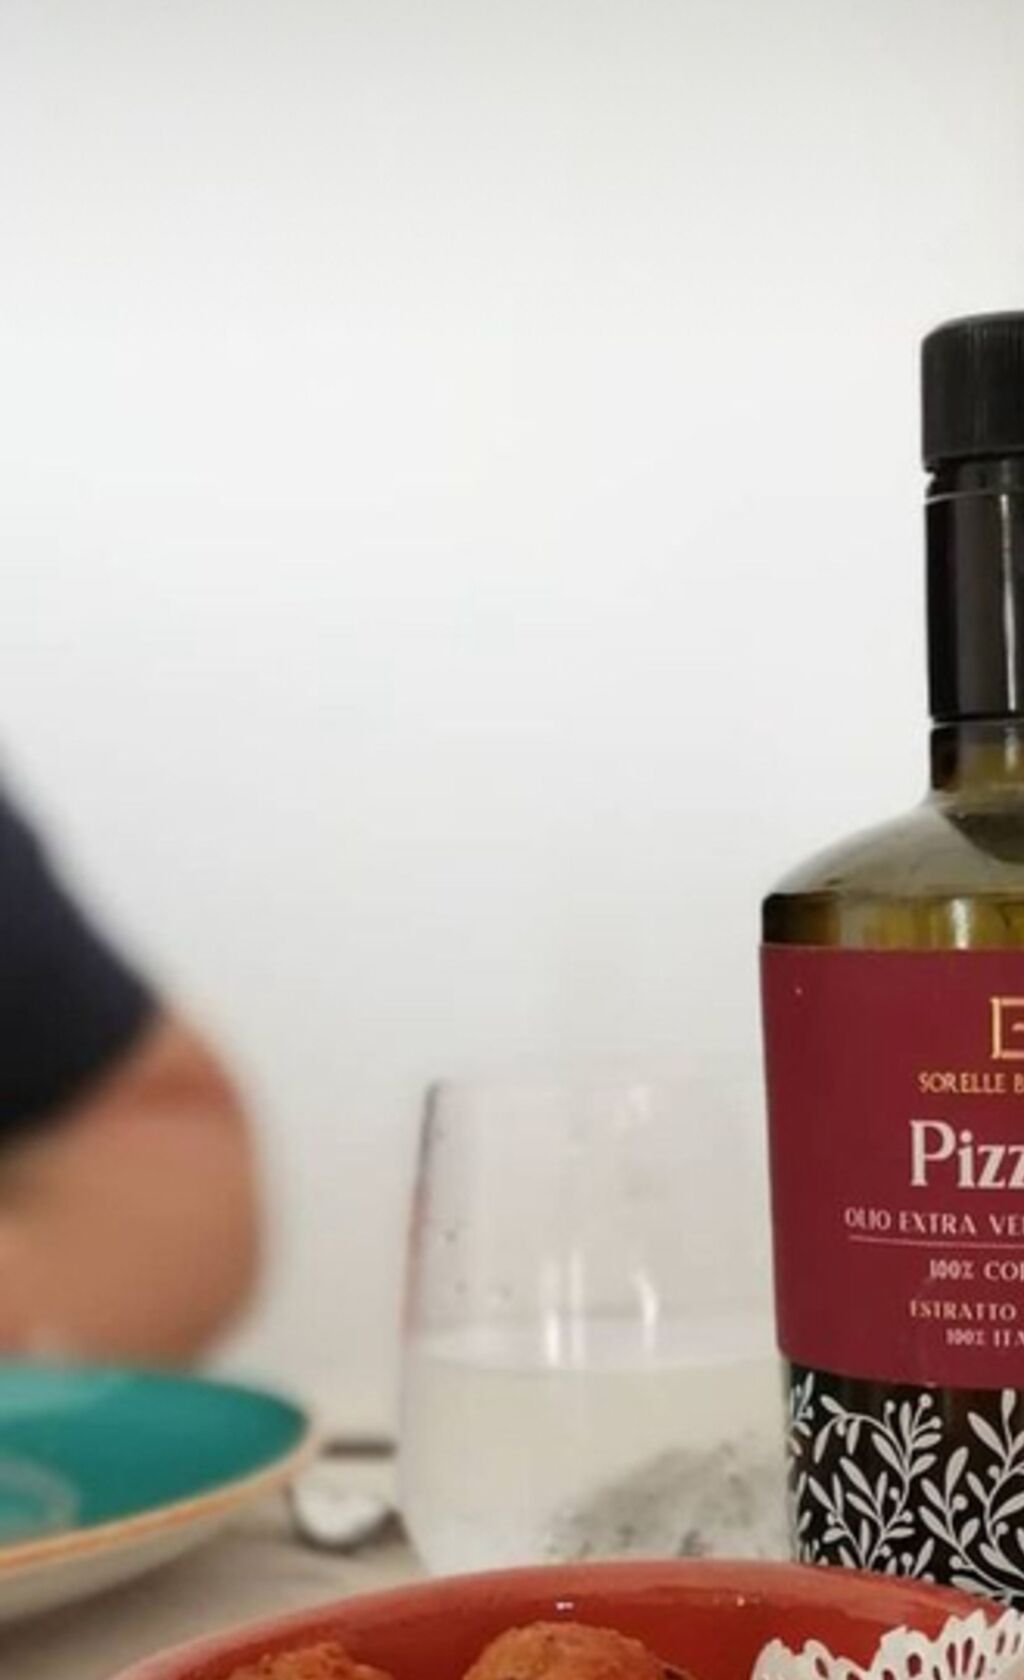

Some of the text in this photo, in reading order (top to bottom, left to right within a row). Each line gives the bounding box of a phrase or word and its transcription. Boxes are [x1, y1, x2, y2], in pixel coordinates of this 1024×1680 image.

[918, 1071, 1006, 1093] SORELLE
[844, 1207, 891, 1231] OLIO
[899, 1211, 976, 1236] EXTRA
[929, 1258, 974, 1281] 100%
[909, 1299, 1017, 1321] ESTRATTO
[946, 1328, 985, 1346] 100%
